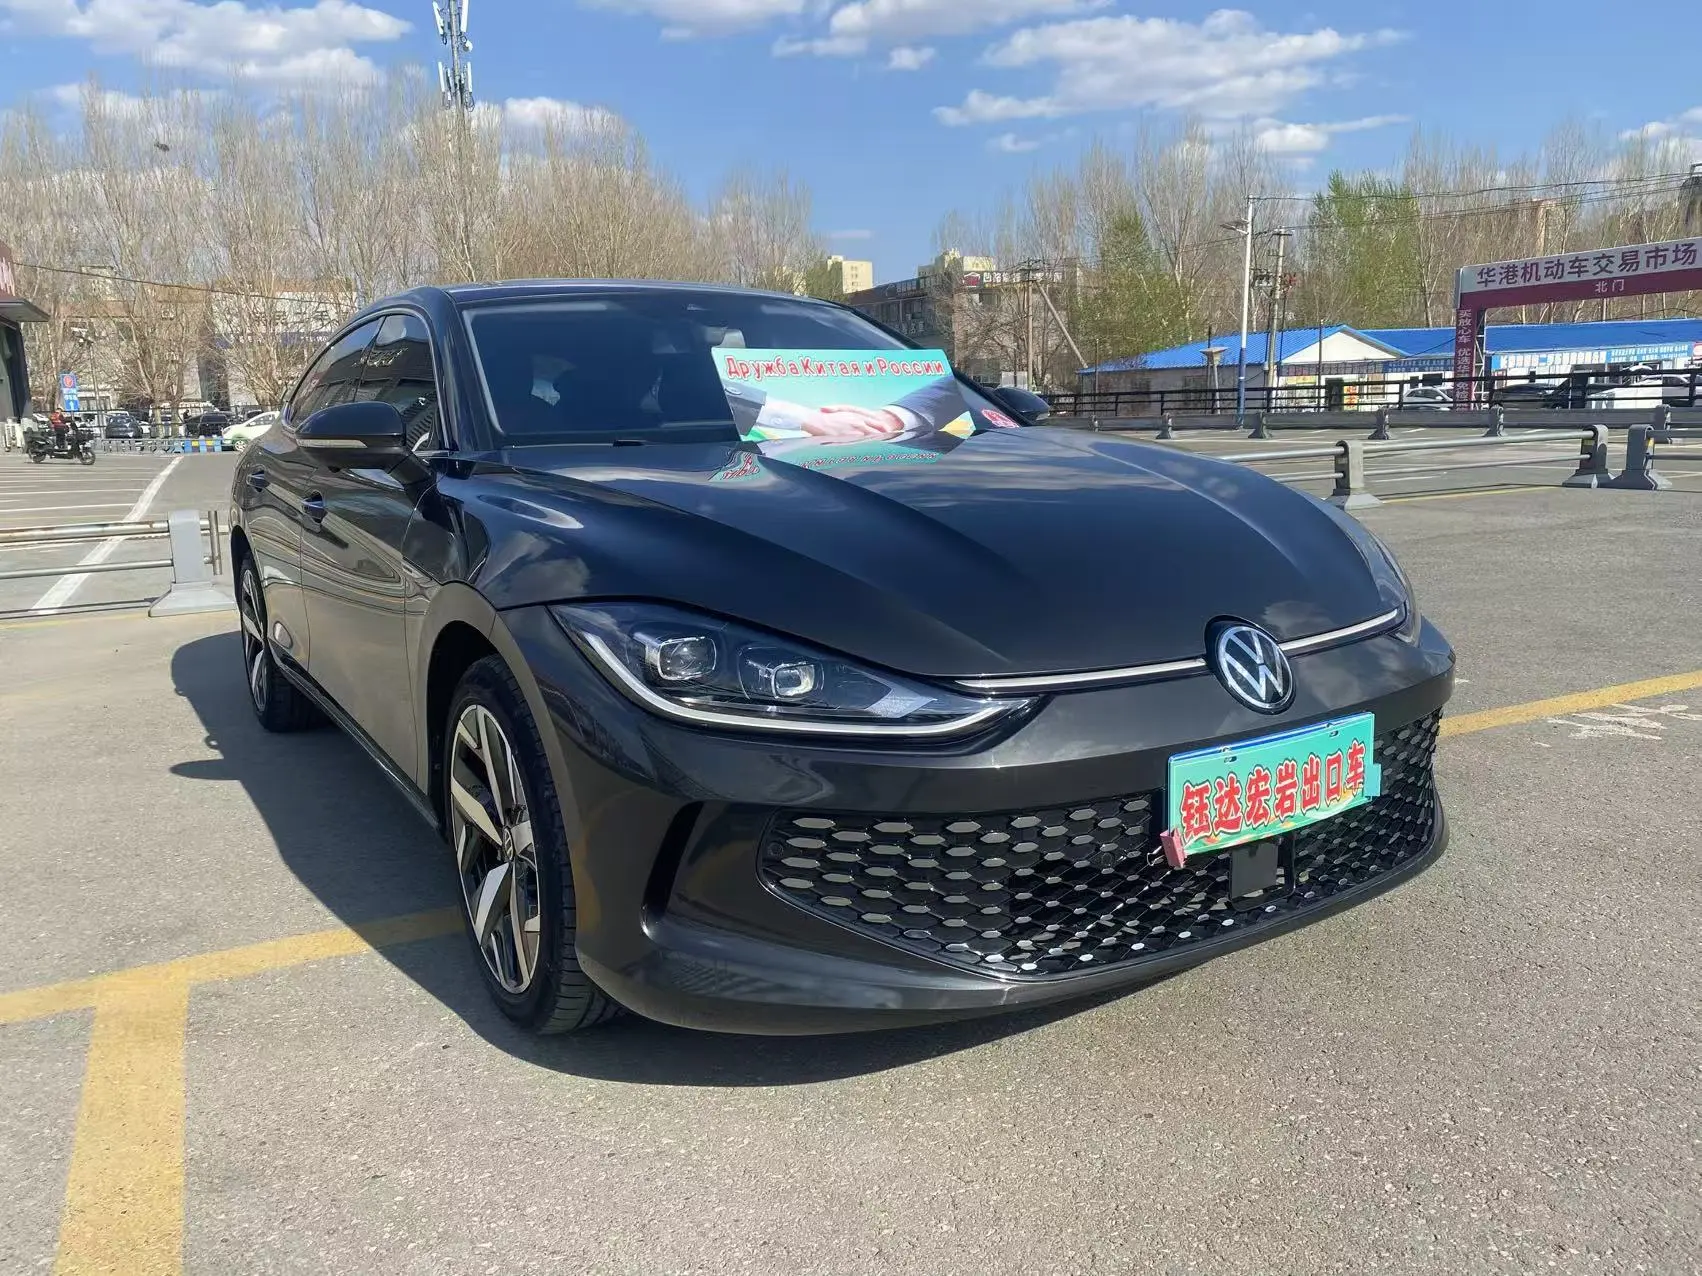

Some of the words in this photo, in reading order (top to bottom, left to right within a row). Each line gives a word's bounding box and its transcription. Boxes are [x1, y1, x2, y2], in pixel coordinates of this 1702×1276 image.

[1477, 242, 1697, 288] 华港机动车交易市场
[1594, 279, 1626, 293] 北门
[725, 355, 800, 381] Дружба
[800, 356, 861, 378] Китая
[863, 360, 876, 376] и
[875, 357, 945, 377] России
[1180, 738, 1366, 843] 钰达宏岩出口车
